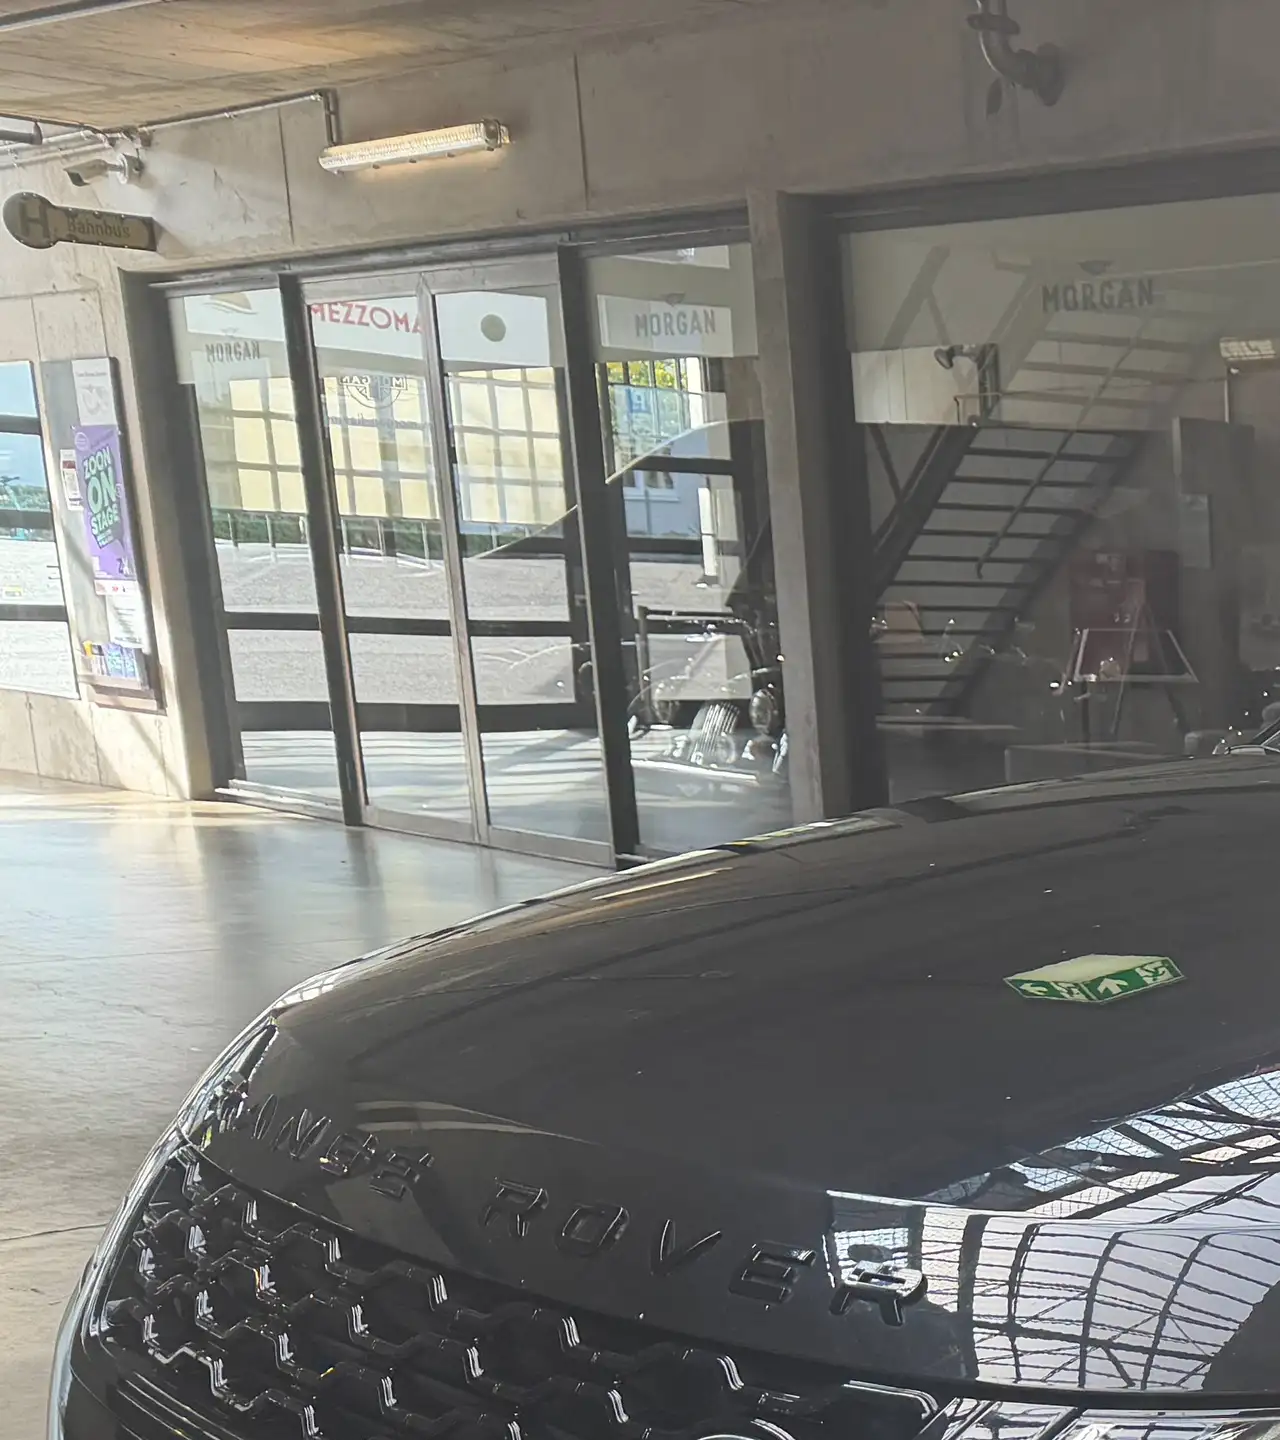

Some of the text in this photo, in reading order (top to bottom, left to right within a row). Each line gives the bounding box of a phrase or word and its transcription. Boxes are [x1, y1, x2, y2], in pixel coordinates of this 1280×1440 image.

[66, 215, 131, 238] Bahnbus
[1042, 278, 1154, 314] MORGAN
[635, 309, 716, 338] MORGAN
[205, 341, 261, 363] MORGAN
[87, 467, 117, 515] ON
[91, 503, 121, 536] STAGE
[478, 1178, 928, 1327] ROVER
